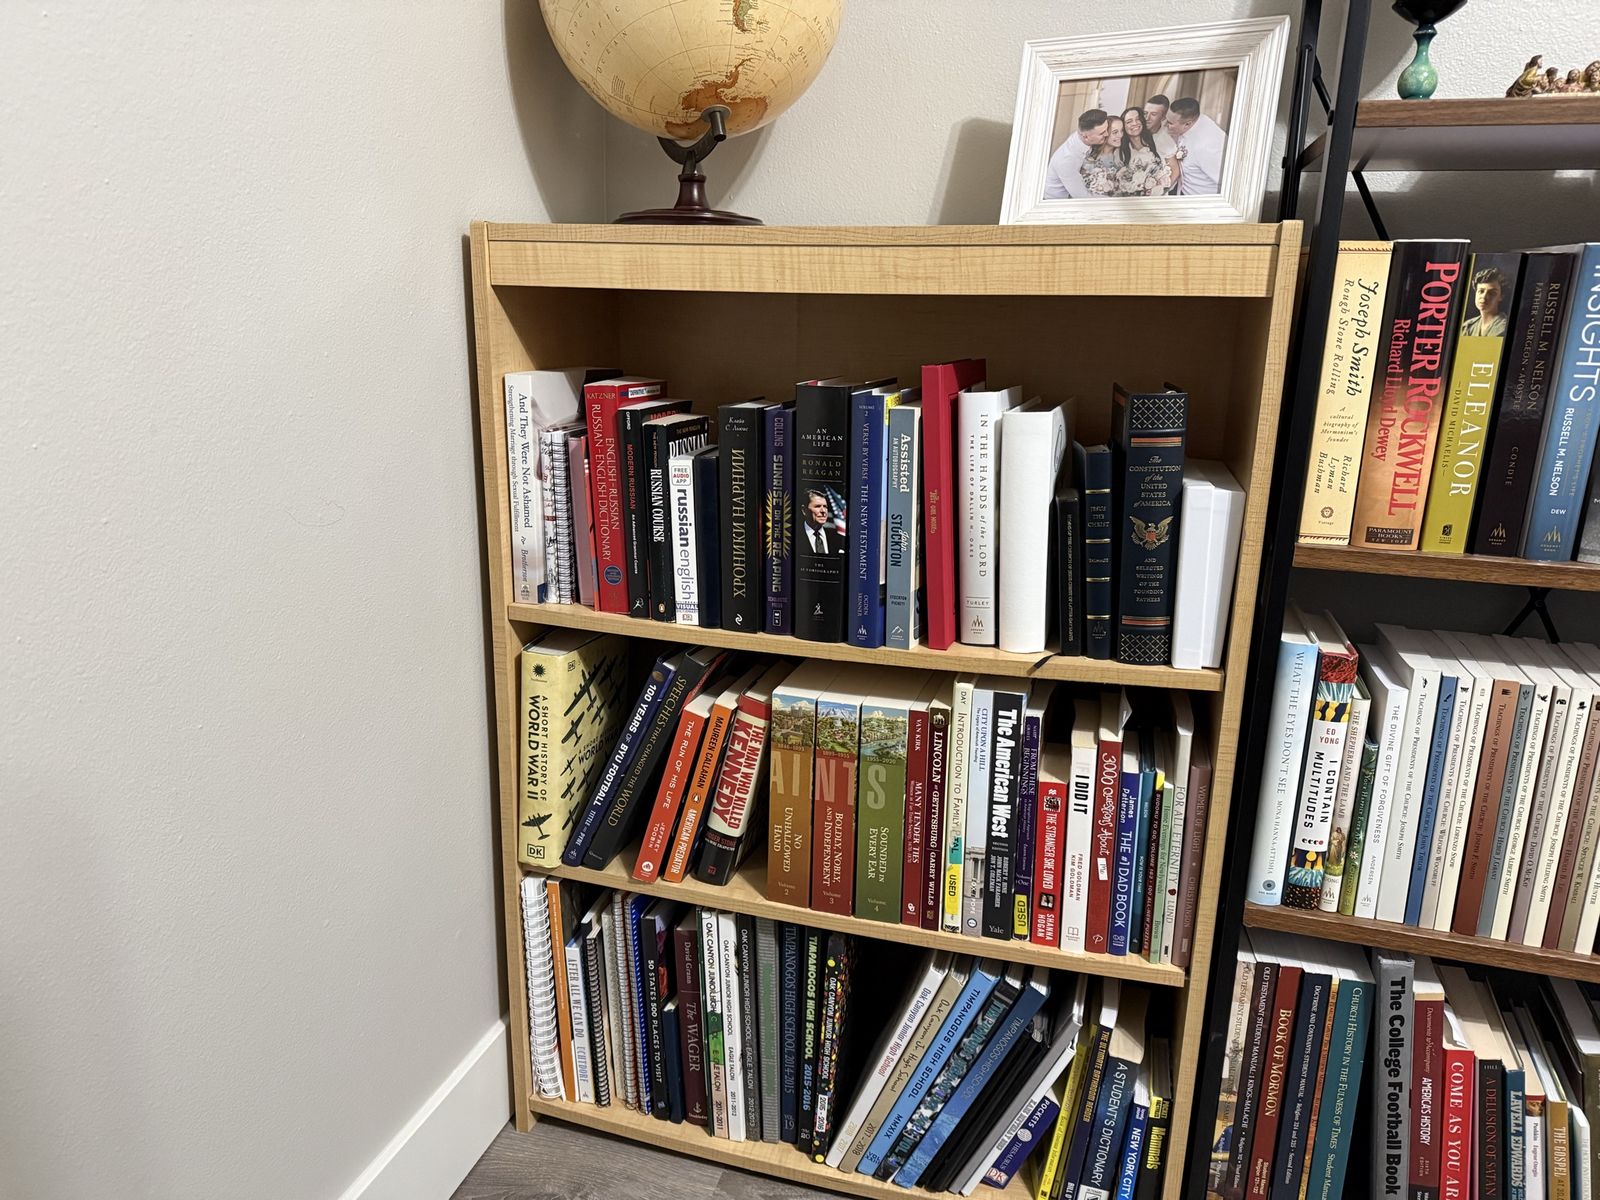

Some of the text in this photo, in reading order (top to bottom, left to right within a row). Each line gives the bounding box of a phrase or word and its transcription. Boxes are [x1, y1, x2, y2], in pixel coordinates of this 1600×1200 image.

[1346, 278, 1379, 396] Joseph Smith
[1526, 282, 1561, 410] RUSSELL M. NELSON
[1387, 261, 1461, 517] PORTER ROCKWELL
[774, 417, 783, 447] COLLINS
[980, 414, 988, 429] IN
[980, 434, 988, 459] THE
[1449, 361, 1494, 496] ELEANOR
[517, 394, 532, 528] And They Were Not Ashamed
[606, 438, 619, 530] ENGLISH-RUSSIAN
[773, 455, 783, 505] SUNRISE
[900, 433, 911, 492] Assisted
[650, 469, 664, 542] RUSSIAN COURSE
[979, 466, 988, 509] HANDS
[598, 500, 611, 561] DICTIONARY
[732, 448, 745, 598] ХРОНИКИ НАРНИИ
[774, 510, 781, 520] ON
[860, 485, 868, 580] THE NEW TESTAMENT
[891, 514, 903, 566] STOCKTON
[980, 515, 986, 523] of
[677, 489, 695, 600] russian english
[772, 542, 781, 592] REAPING
[899, 531, 910, 552] John
[979, 544, 987, 577] LORD
[1292, 652, 1304, 684] WHAT
[1289, 689, 1300, 710] THE
[1414, 693, 1426, 727] TEACHINGS
[528, 695, 540, 800] WORLD WAR II
[593, 685, 657, 806] 100 YEARS OF BYU FOOTBALL
[1284, 713, 1296, 738] EYES
[663, 720, 694, 809] THE RUN OF HIS LIFE
[697, 716, 723, 788] MAUREEN CALLAHAN
[713, 718, 753, 823] KENNEDY
[728, 724, 766, 829] THE MAN WHO KILLED
[932, 731, 943, 783] LINCOLN
[992, 709, 1017, 838] The American West
[1373, 705, 1400, 843] THE DIVINE GIFT OF FORGIVENESS
[1407, 737, 1420, 771] PRESIDENTS
[1409, 772, 1415, 780] OF
[541, 788, 546, 801] OF
[1074, 802, 1088, 814] IT
[1075, 782, 1089, 800] DID
[1277, 774, 1290, 794] SEE
[1303, 751, 1323, 829] MULTITUDES
[1320, 770, 1336, 823] CONTAIN
[1401, 794, 1412, 818] CHURCH:
[1406, 782, 1414, 792] THE
[671, 809, 697, 874] AMERICAN PREDATOR
[774, 824, 782, 851] HAND
[783, 807, 793, 872] UNHALLOWED
[794, 834, 802, 849] NO
[930, 790, 939, 848] GETTYSBURG
[1398, 819, 1410, 841] JOSEPH
[867, 827, 878, 879] EVERY EAR
[1395, 842, 1403, 860] SMITH
[949, 874, 957, 897] USED
[1115, 832, 1131, 927] THE #1 DAD BOOK
[1037, 914, 1046, 937] HOGAN
[1046, 914, 1054, 940] SHANNA
[648, 960, 655, 970] 50
[649, 972, 657, 1000] STATES
[652, 1020, 660, 1049] PLACES
[686, 1002, 700, 1071] The WAGER
[803, 937, 817, 1110] TIMPANOGOS HIGH SCHOOL 2015-2016
[655, 1052, 661, 1061] TO
[884, 989, 980, 1139] TIMPANOGOS HIGH SCHOOL MMXIX
[1118, 1062, 1127, 1071] A
[1264, 1009, 1291, 1117] BOOK OF MORMON
[1384, 977, 1406, 1195] The College Football Book
[1028, 1099, 1050, 1128] POCKETS
[1420, 1115, 1430, 1145] HISTORY
[1447, 1062, 1464, 1171] COME AS YOU
[1510, 1090, 1523, 1187] LAVELL EDWARDS
[1090, 1128, 1114, 1186] DICTIONARY
[1121, 1128, 1140, 1199] NEW YORK CITY
[1146, 1127, 1166, 1169] Mammals
[988, 1168, 1009, 1182] DK
